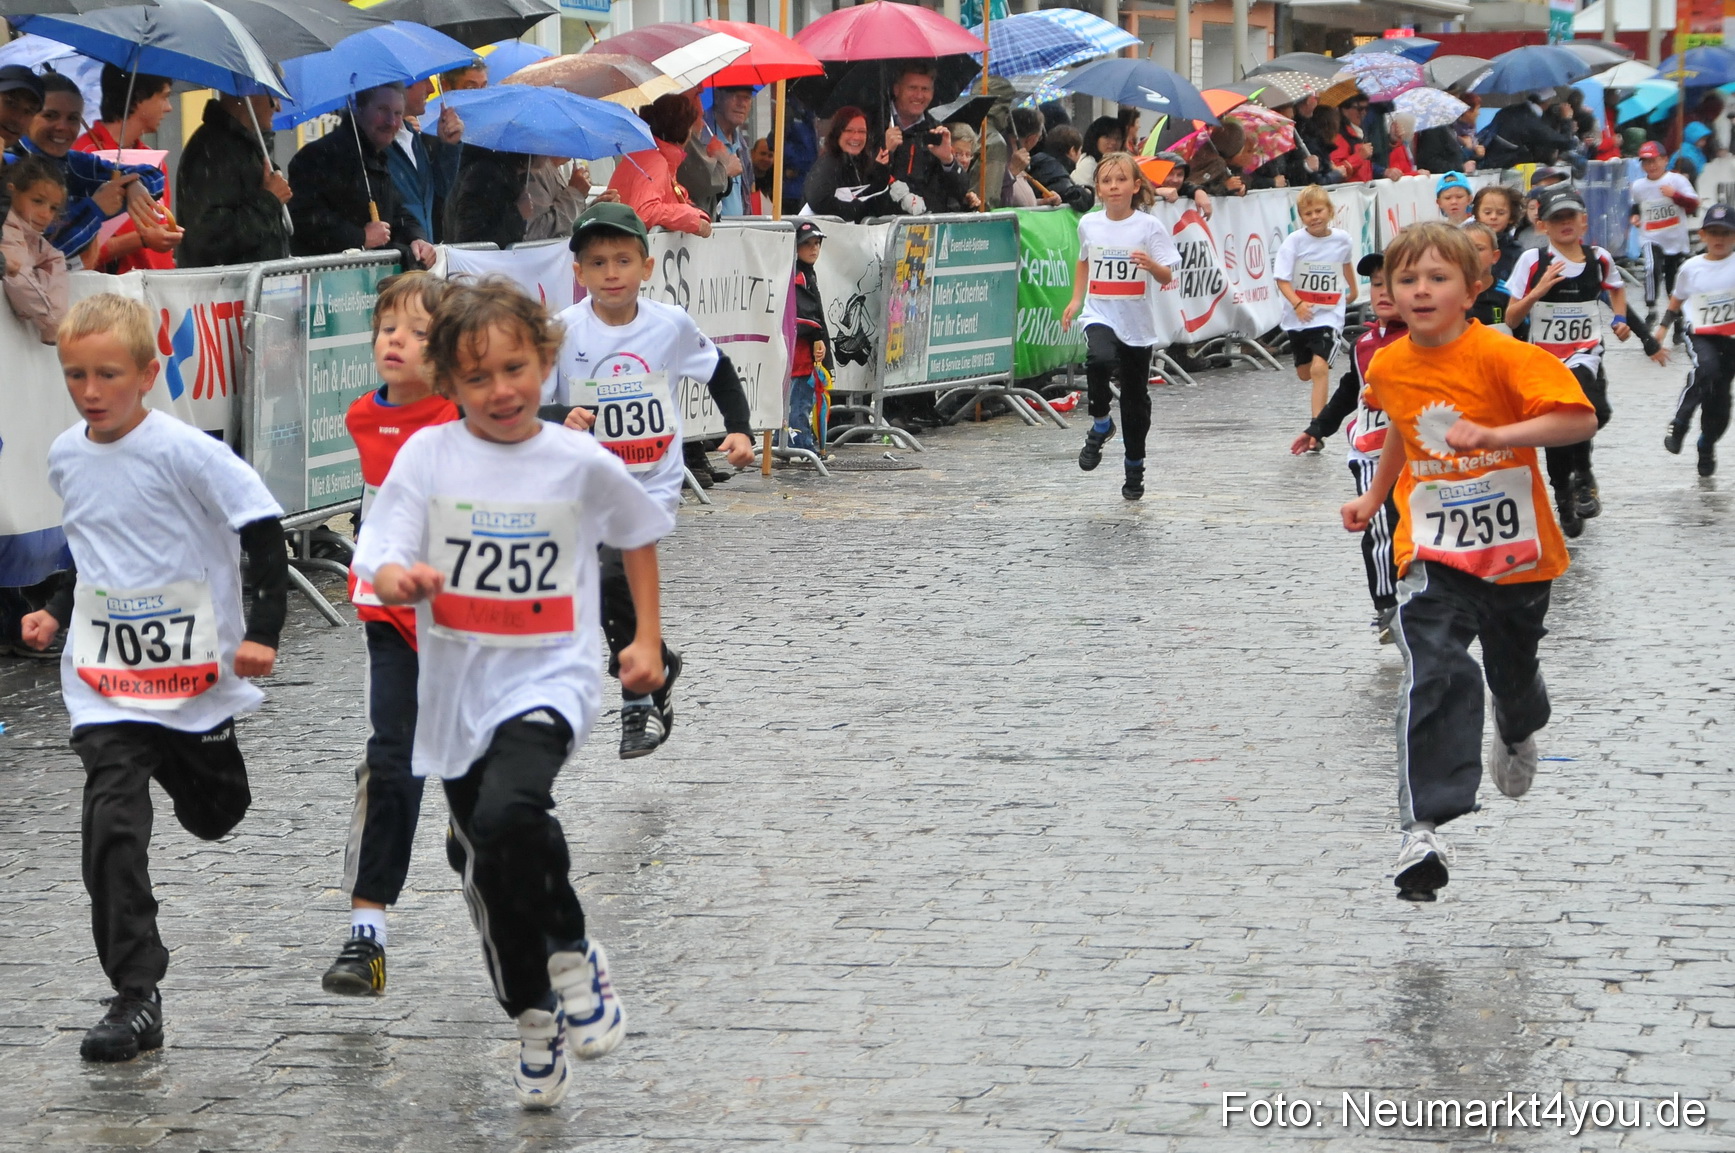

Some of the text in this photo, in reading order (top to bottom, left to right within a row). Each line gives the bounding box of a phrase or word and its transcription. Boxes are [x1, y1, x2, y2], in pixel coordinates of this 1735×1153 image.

[1646, 205, 1676, 221] 7306
[1018, 249, 1070, 287] Herzlich
[1094, 260, 1140, 280] 7197
[935, 279, 989, 305] Mehr Sicherheit
[1300, 273, 1338, 291] 7061
[933, 312, 979, 337] für Ihr Event!
[1699, 303, 1735, 325] 722
[1541, 318, 1593, 341] 7366
[312, 362, 329, 394] Fun
[331, 359, 339, 392] &
[340, 355, 368, 390] Action
[930, 358, 941, 373] Miet
[945, 356, 961, 372] Service
[597, 381, 643, 396] BOCK
[582, 399, 665, 438] 7030
[1458, 448, 1515, 474] Reisen
[311, 476, 325, 498] Miet
[325, 474, 331, 495] &
[331, 470, 350, 491] Service
[1439, 480, 1492, 500] BOCK
[471, 511, 536, 528] BOCK
[1426, 498, 1520, 548] 7259
[446, 537, 559, 593] 7252
[107, 595, 164, 612] BOCK
[91, 615, 195, 666] 7037
[99, 674, 200, 693] Alexander
[202, 735, 226, 743] JAKO
